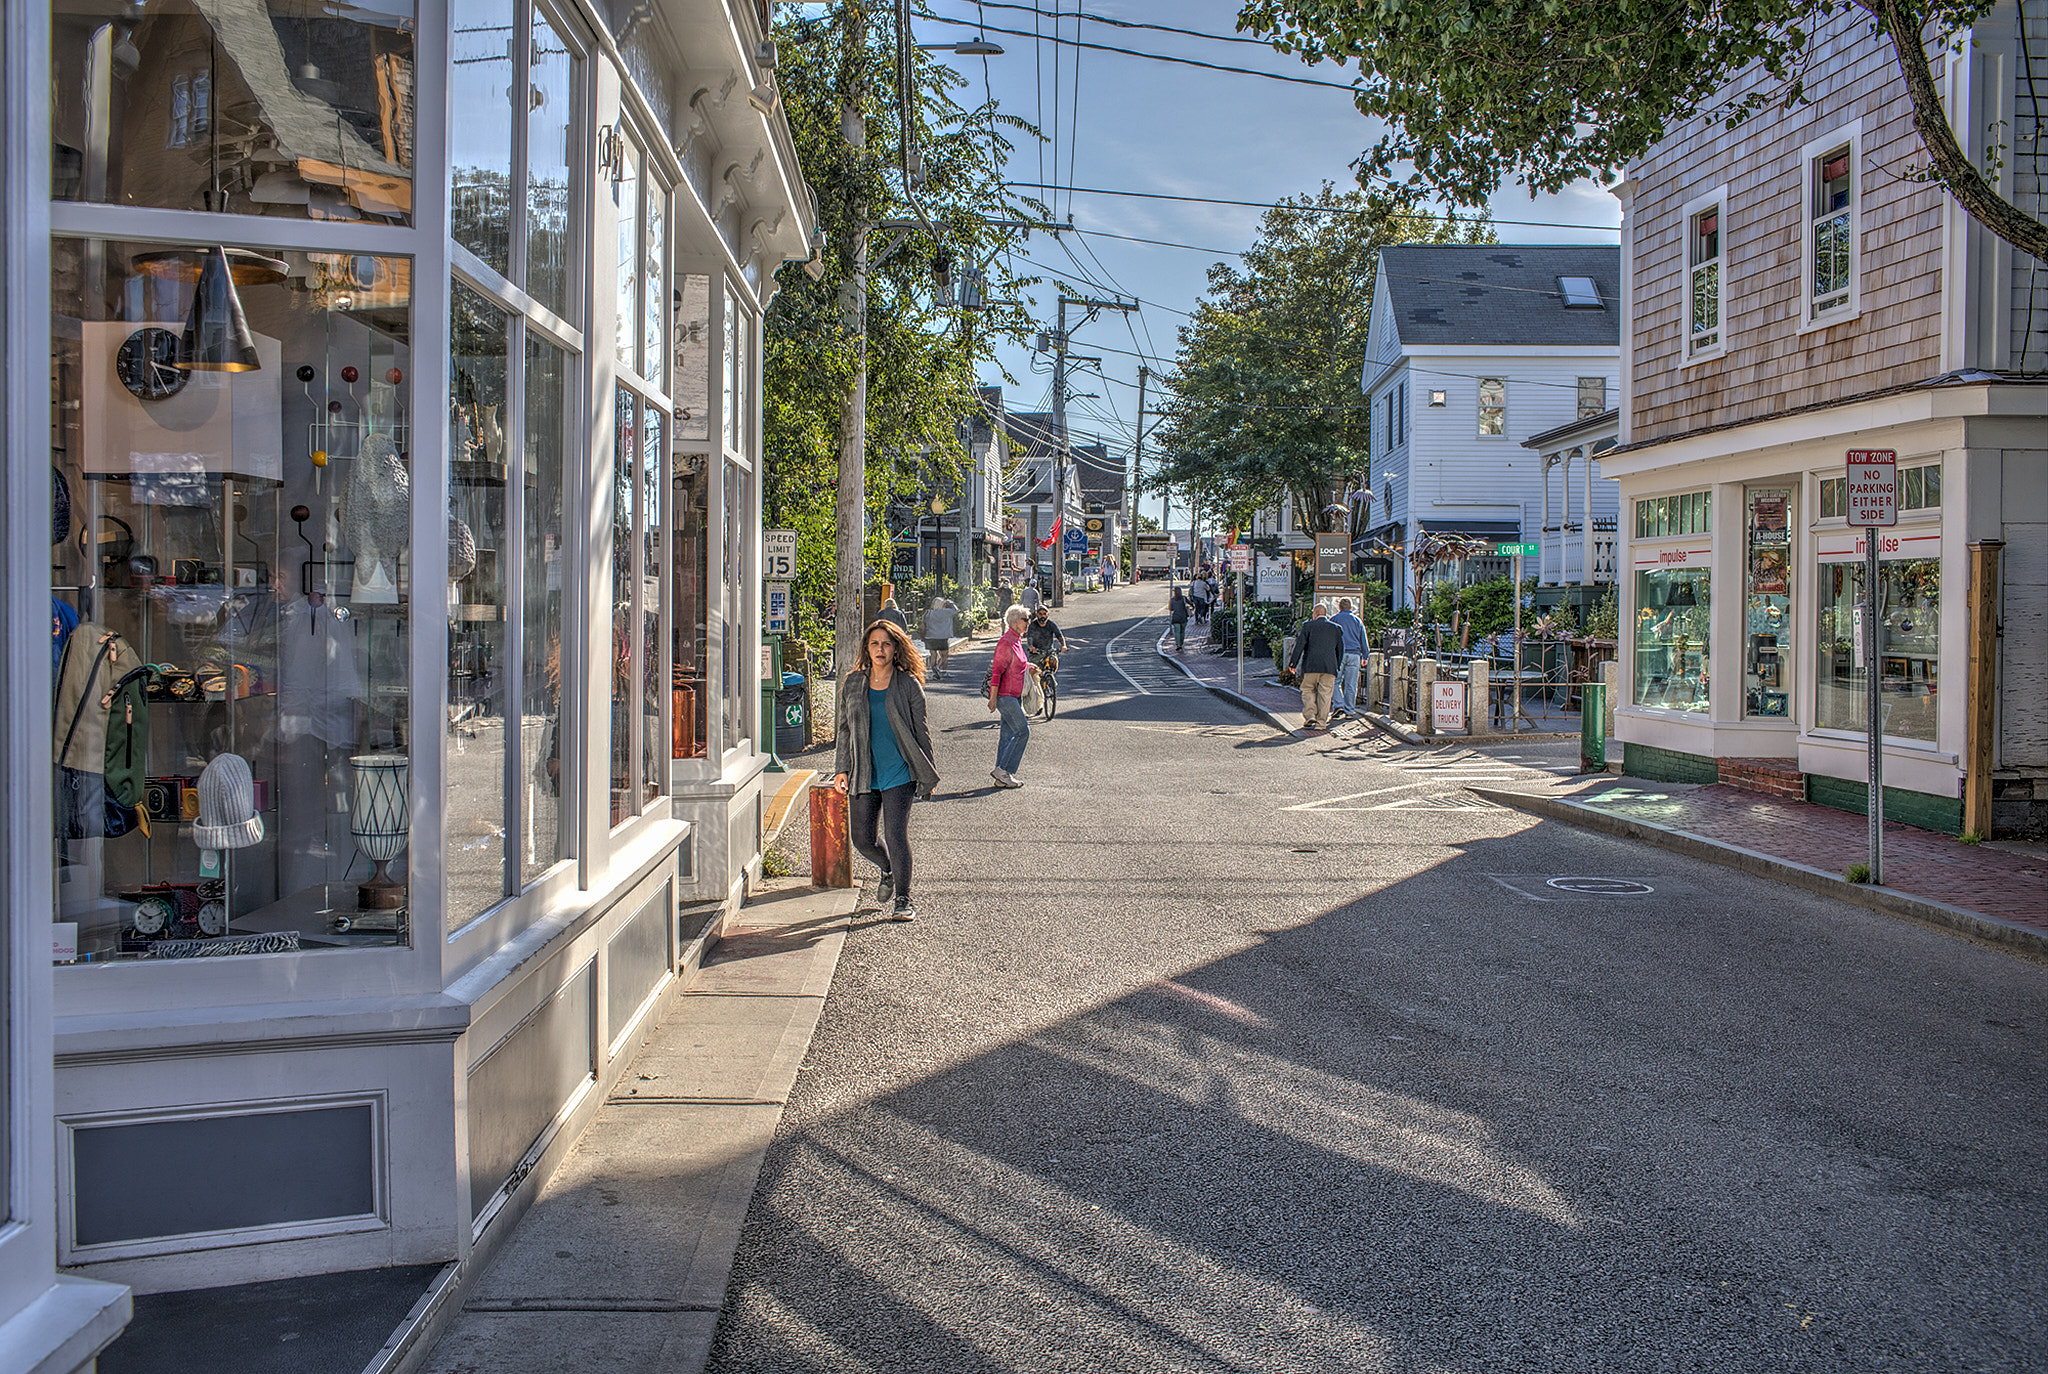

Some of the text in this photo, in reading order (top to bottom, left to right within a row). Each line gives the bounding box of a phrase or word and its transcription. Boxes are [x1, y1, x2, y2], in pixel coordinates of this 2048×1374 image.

[1850, 452, 1894, 463] TOW ZONE
[1863, 470, 1881, 480] NO
[1849, 483, 1894, 494] PARKING
[1852, 497, 1892, 507] EITHER
[1860, 510, 1885, 520] SIDE
[765, 534, 795, 543] SPEED
[768, 545, 791, 554] LIMIT
[1320, 547, 1343, 555] LOCAL
[1501, 544, 1525, 555] COURT
[1659, 548, 1687, 567] impulse
[767, 556, 790, 575] 15
[1442, 687, 1454, 697] NO
[1435, 699, 1461, 710] DELIVERY
[1438, 714, 1459, 724] TRUCKS
